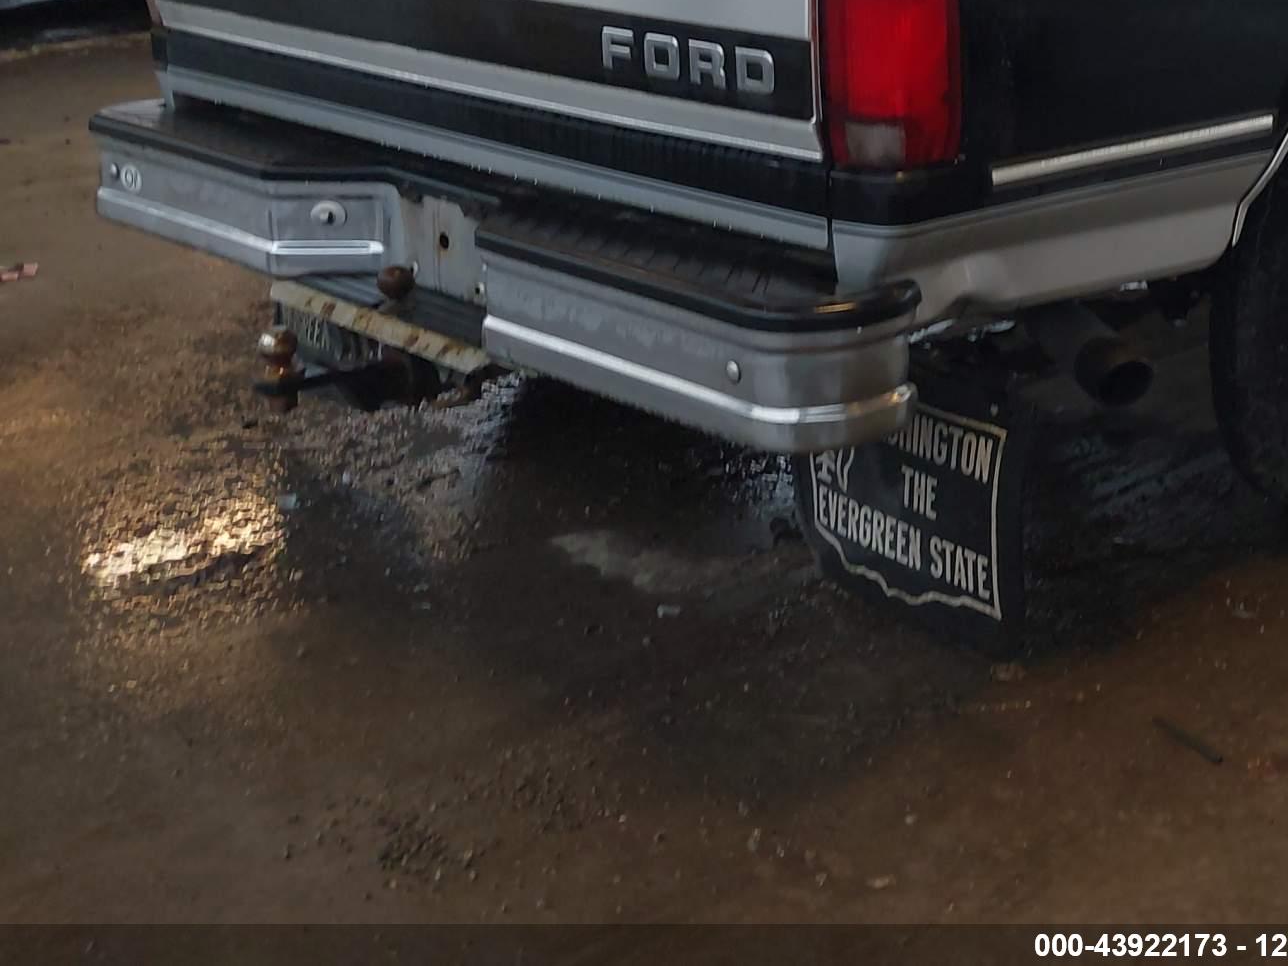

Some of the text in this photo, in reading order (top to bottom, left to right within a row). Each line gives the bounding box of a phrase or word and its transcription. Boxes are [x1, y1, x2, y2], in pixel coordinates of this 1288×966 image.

[601, 25, 775, 95] FORD
[901, 464, 938, 521] THE
[819, 488, 991, 600] EVERGREEN STATE
